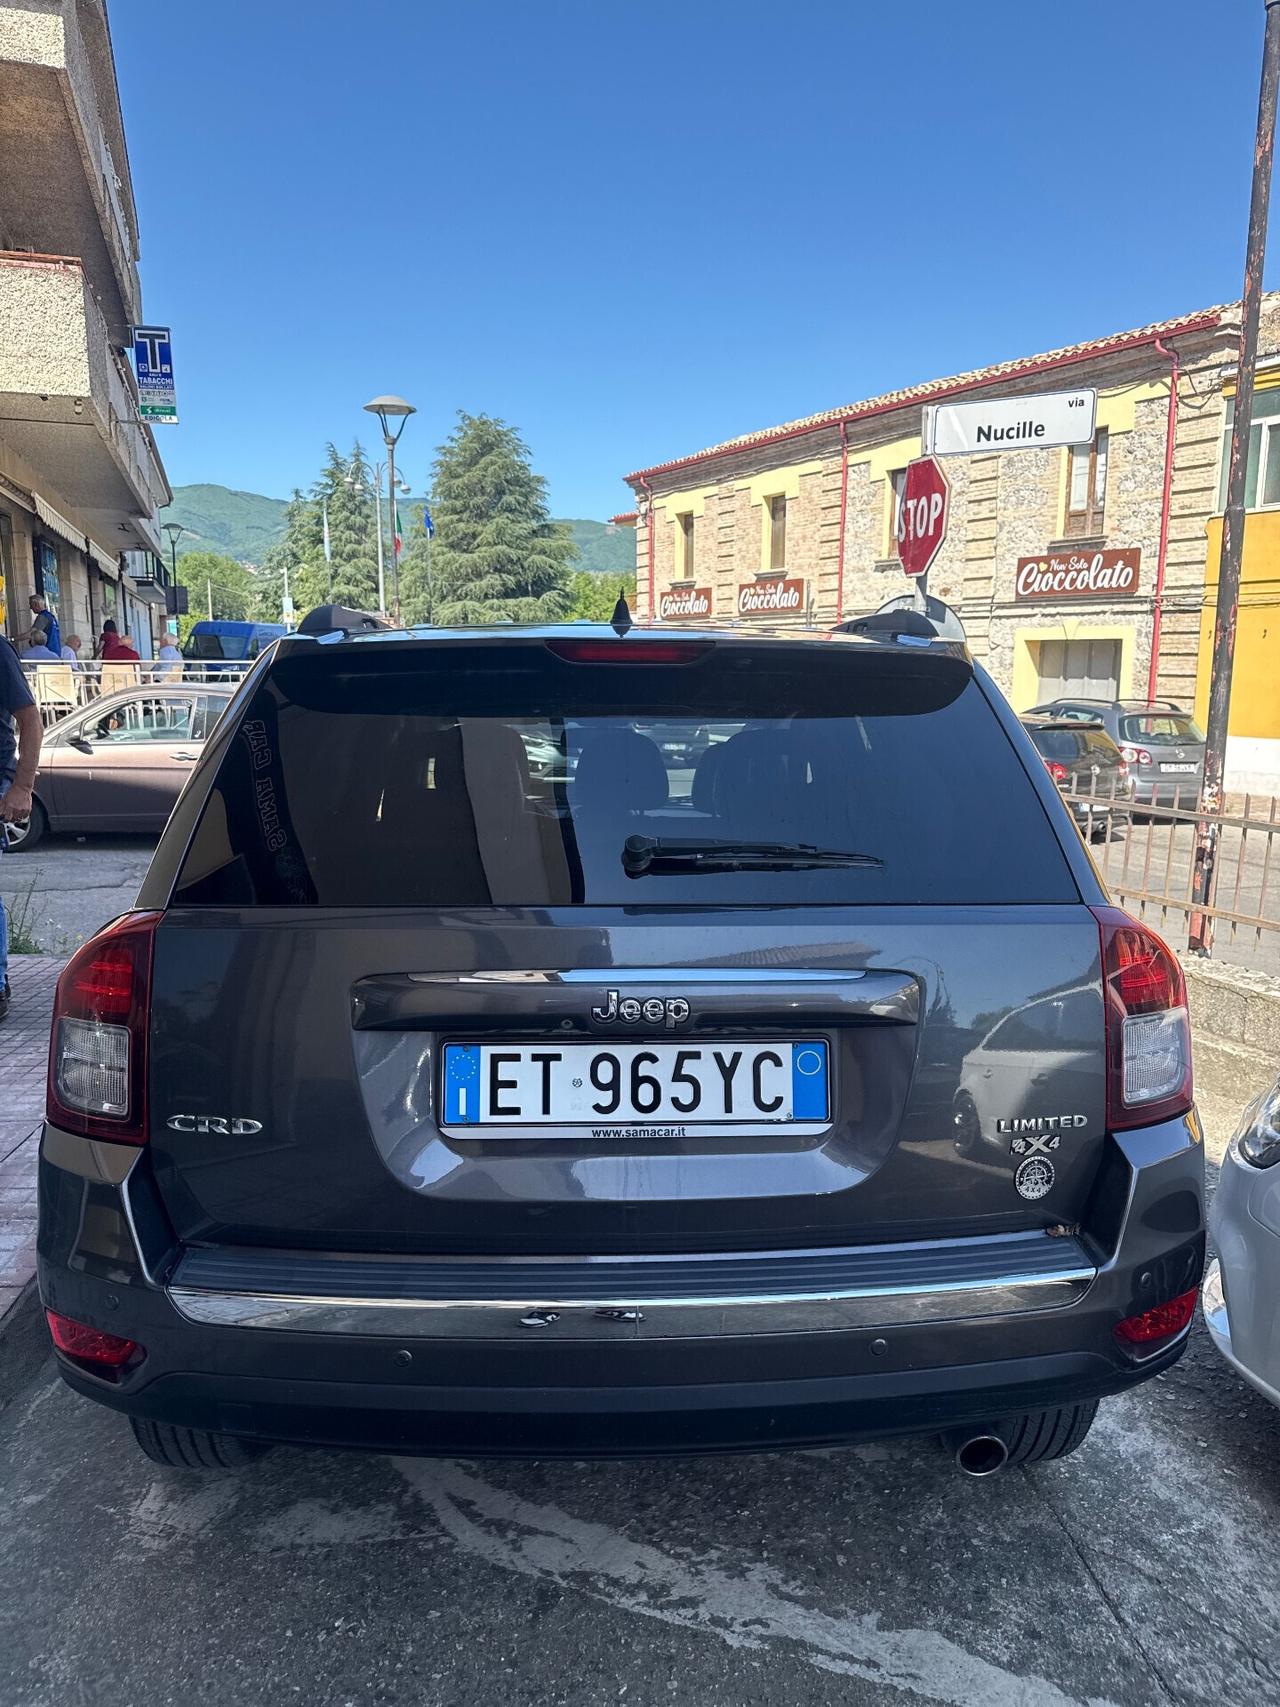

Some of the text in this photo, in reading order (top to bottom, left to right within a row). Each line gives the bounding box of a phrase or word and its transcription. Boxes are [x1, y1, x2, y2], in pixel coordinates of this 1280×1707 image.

[135, 330, 168, 373] T
[139, 376, 173, 385] TABACCHI
[1068, 398, 1085, 408] via
[976, 421, 1046, 443] Nucille
[899, 493, 943, 542] STOP
[1017, 553, 1133, 595] Cioccolato
[1050, 556, 1088, 571] Non Solo
[660, 590, 709, 618] Cioccolato
[739, 582, 800, 612] Cioccolato
[592, 989, 691, 1028] Jeep
[489, 1053, 562, 1116] ET
[589, 1050, 784, 1115] 965YC
[166, 1114, 263, 1135] CRD
[591, 1127, 687, 1138] www.samacar.it
[998, 1114, 1088, 1133] LIMITED
